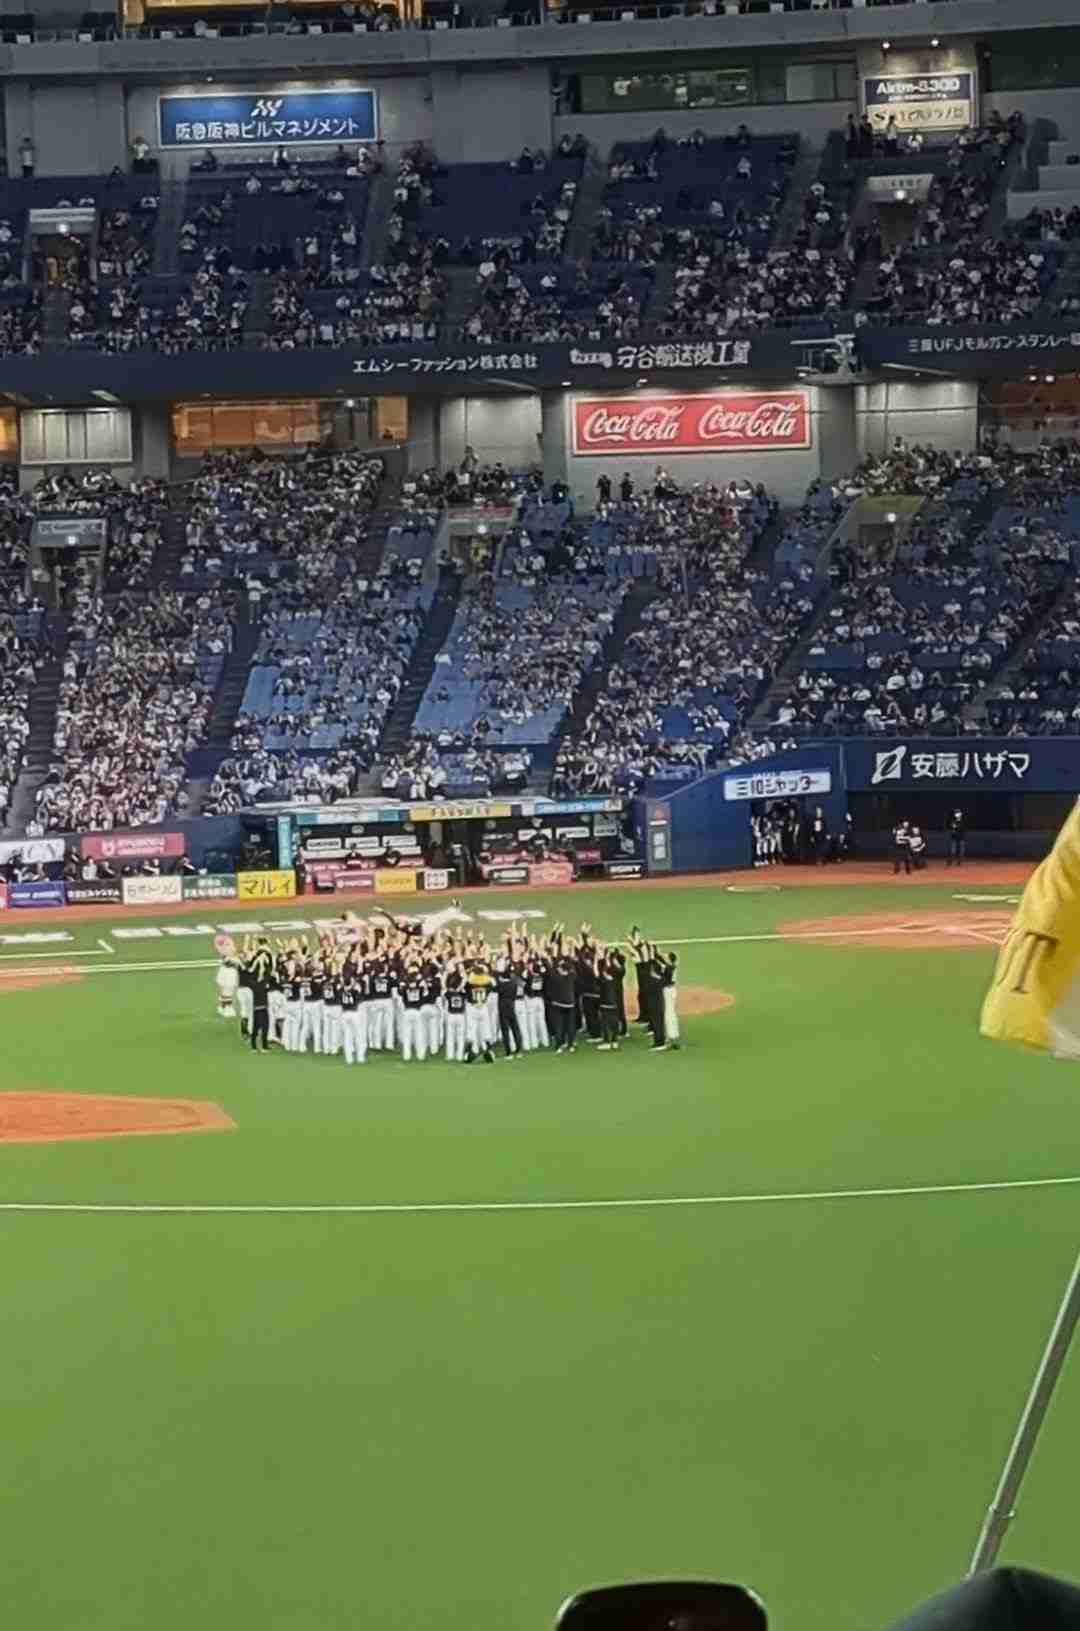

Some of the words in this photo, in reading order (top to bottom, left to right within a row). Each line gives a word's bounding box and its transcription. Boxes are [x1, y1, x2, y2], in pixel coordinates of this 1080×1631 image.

[911, 750, 1031, 778] 安藤ハザマ
